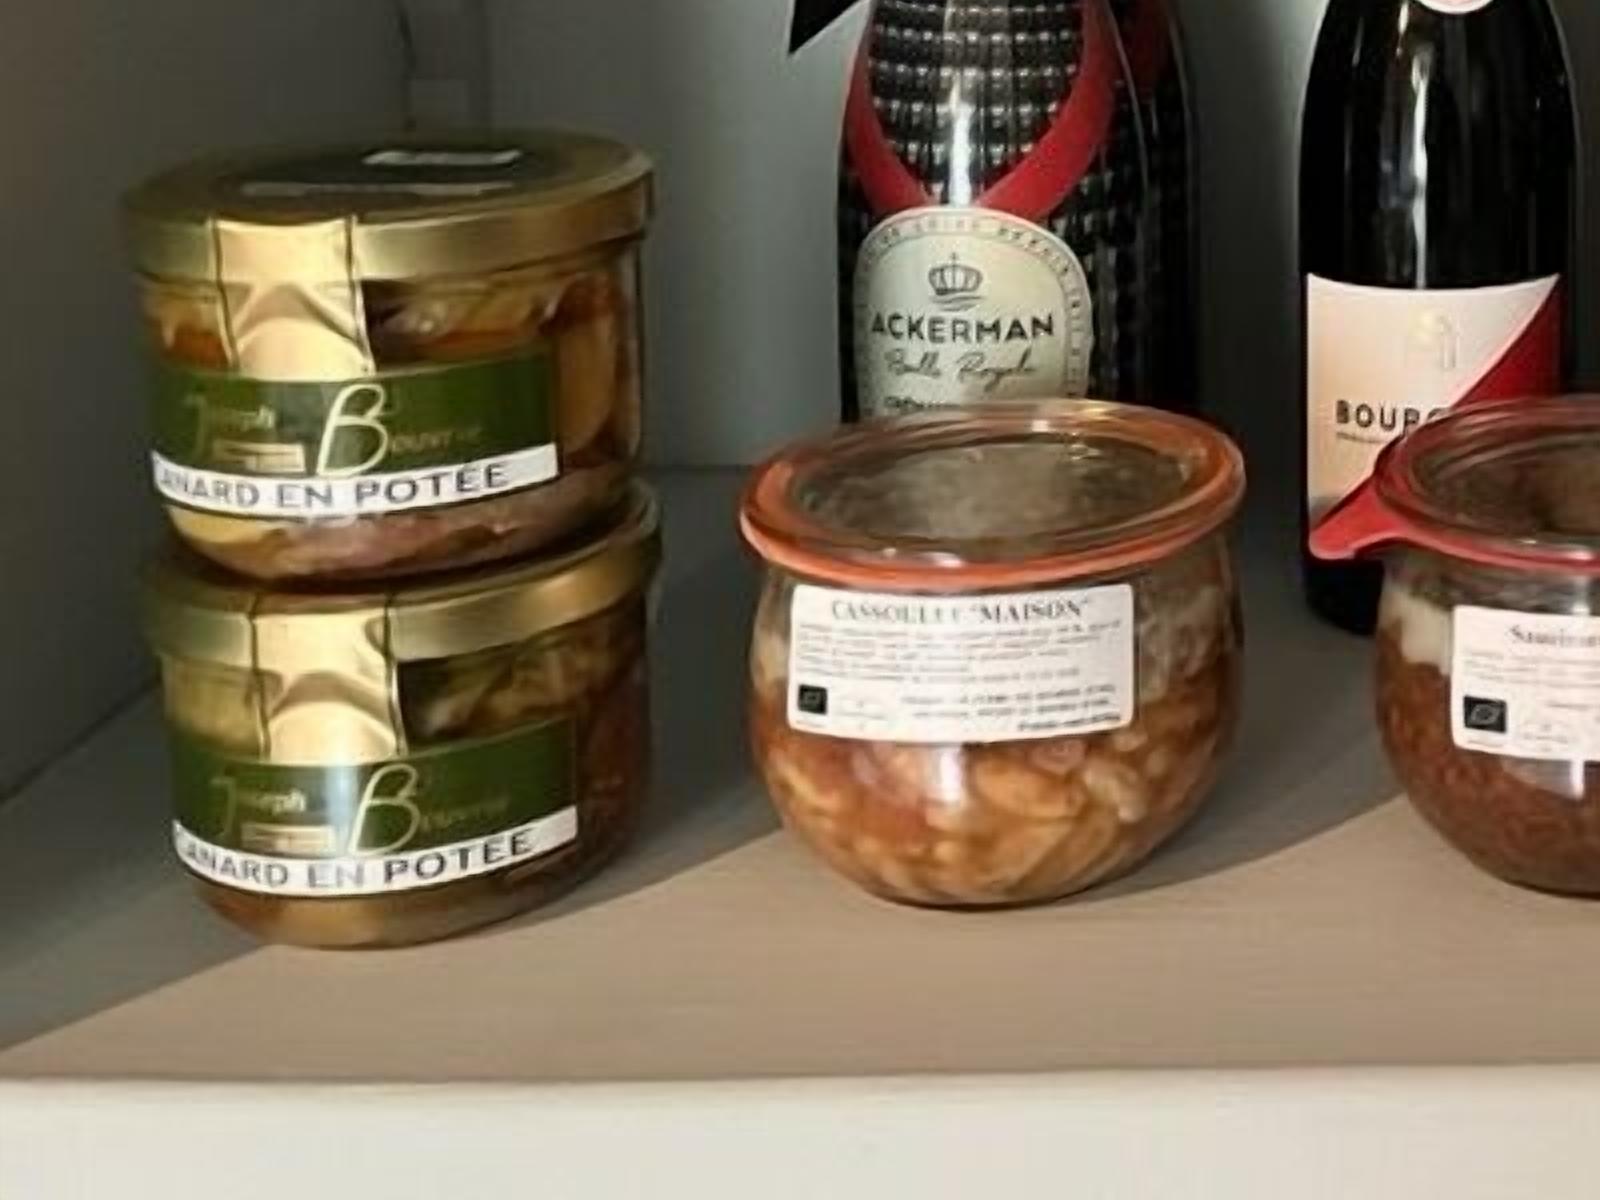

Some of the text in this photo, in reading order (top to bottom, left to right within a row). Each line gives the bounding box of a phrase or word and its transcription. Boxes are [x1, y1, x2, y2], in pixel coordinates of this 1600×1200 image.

[870, 311, 1055, 345] ACKERMAN
[160, 468, 261, 508] ANARD
[277, 483, 334, 508] EN
[184, 842, 288, 888] ANARD
[307, 862, 364, 888] EN
